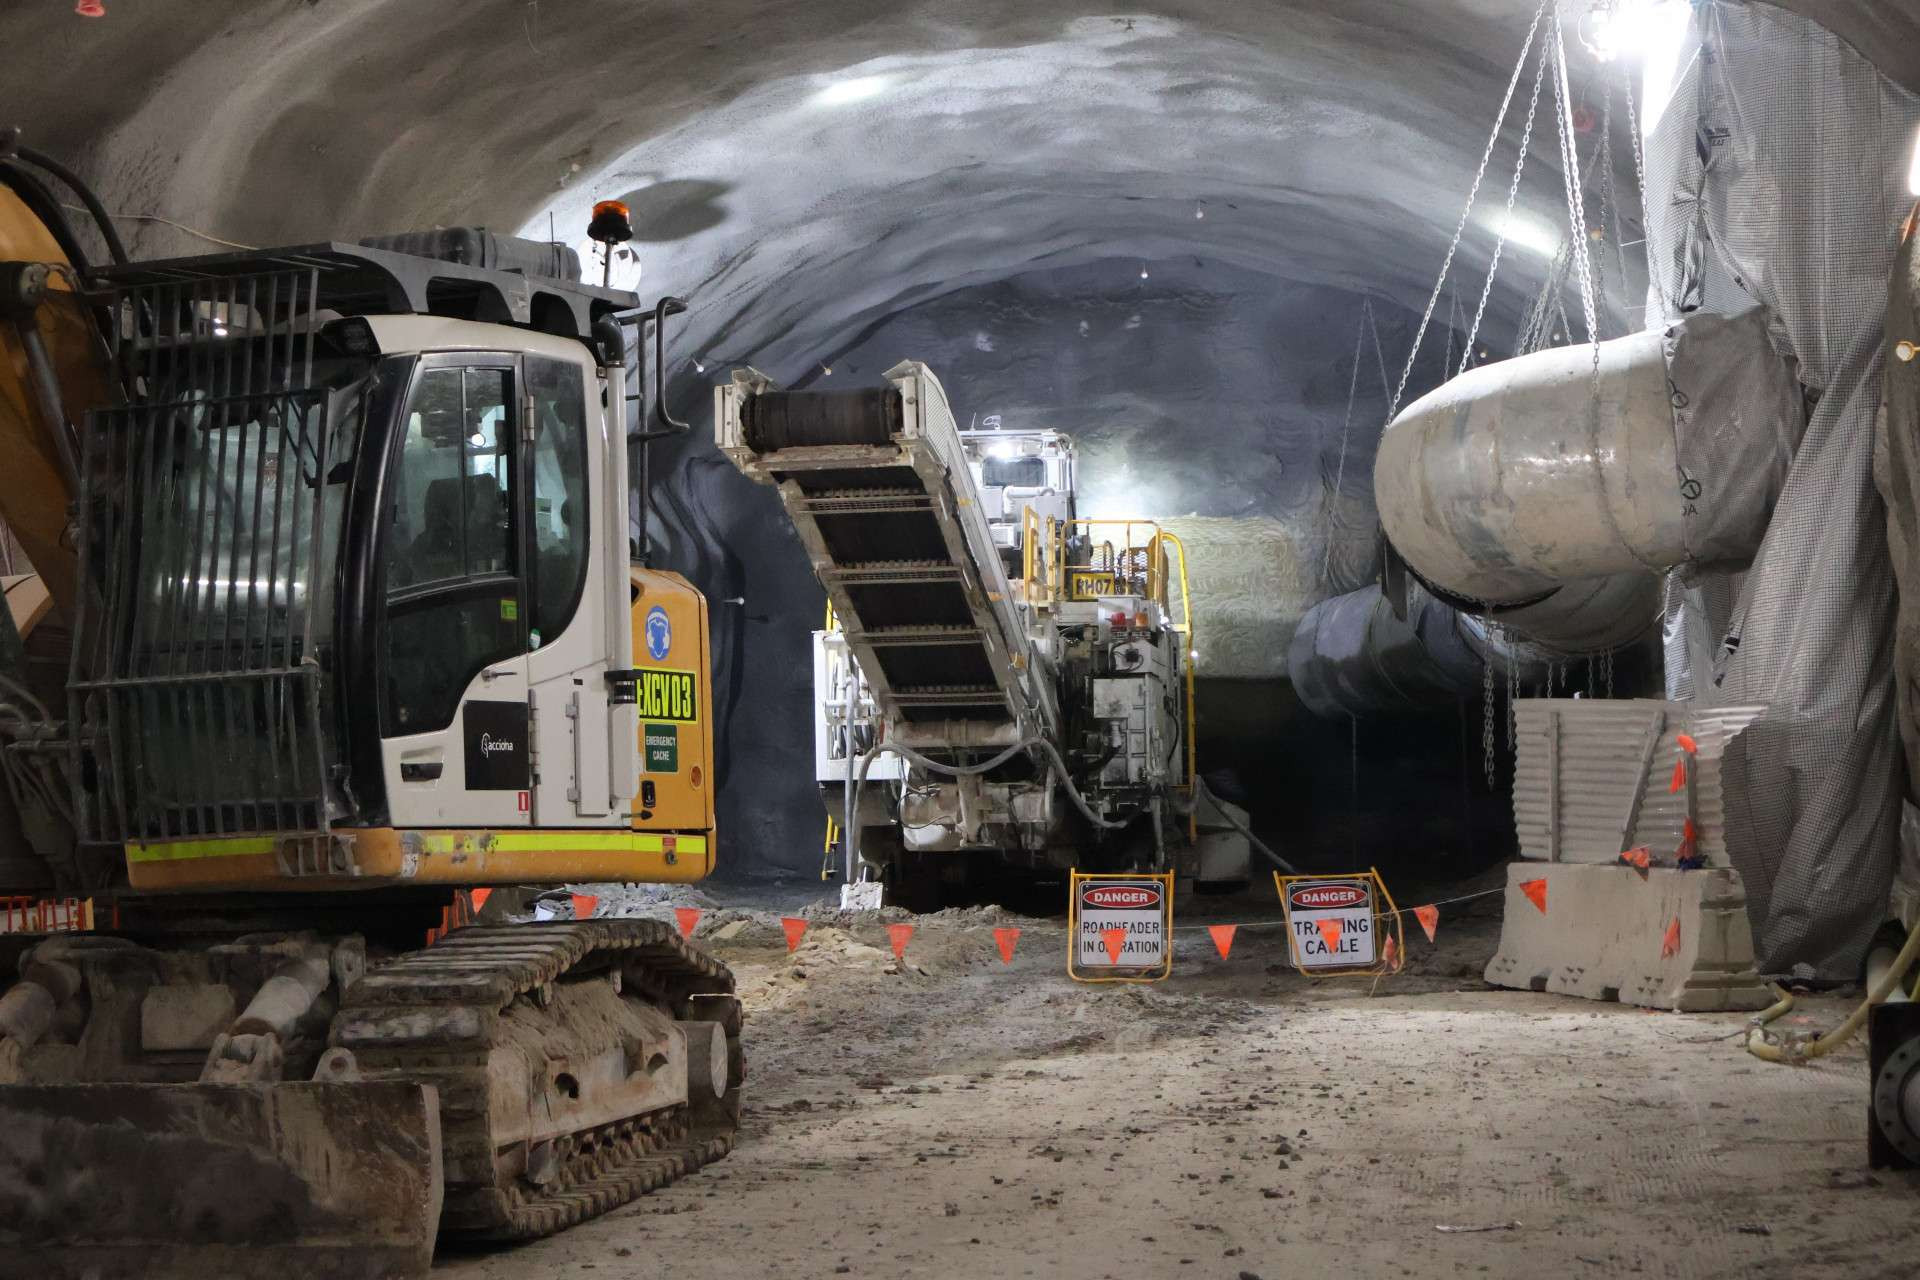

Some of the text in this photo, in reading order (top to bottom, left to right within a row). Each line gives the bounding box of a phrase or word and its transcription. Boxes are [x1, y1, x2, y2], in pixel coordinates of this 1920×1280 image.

[1076, 578, 1112, 595] RH07
[645, 735, 676, 746] EMERGENCY
[652, 750, 670, 761] CACHE
[1094, 892, 1148, 902] DANGER
[1302, 890, 1357, 903] DANGER
[1294, 918, 1369, 936] TRING
[1083, 940, 1160, 953] IN ORATION
[1305, 938, 1359, 955] CALE
